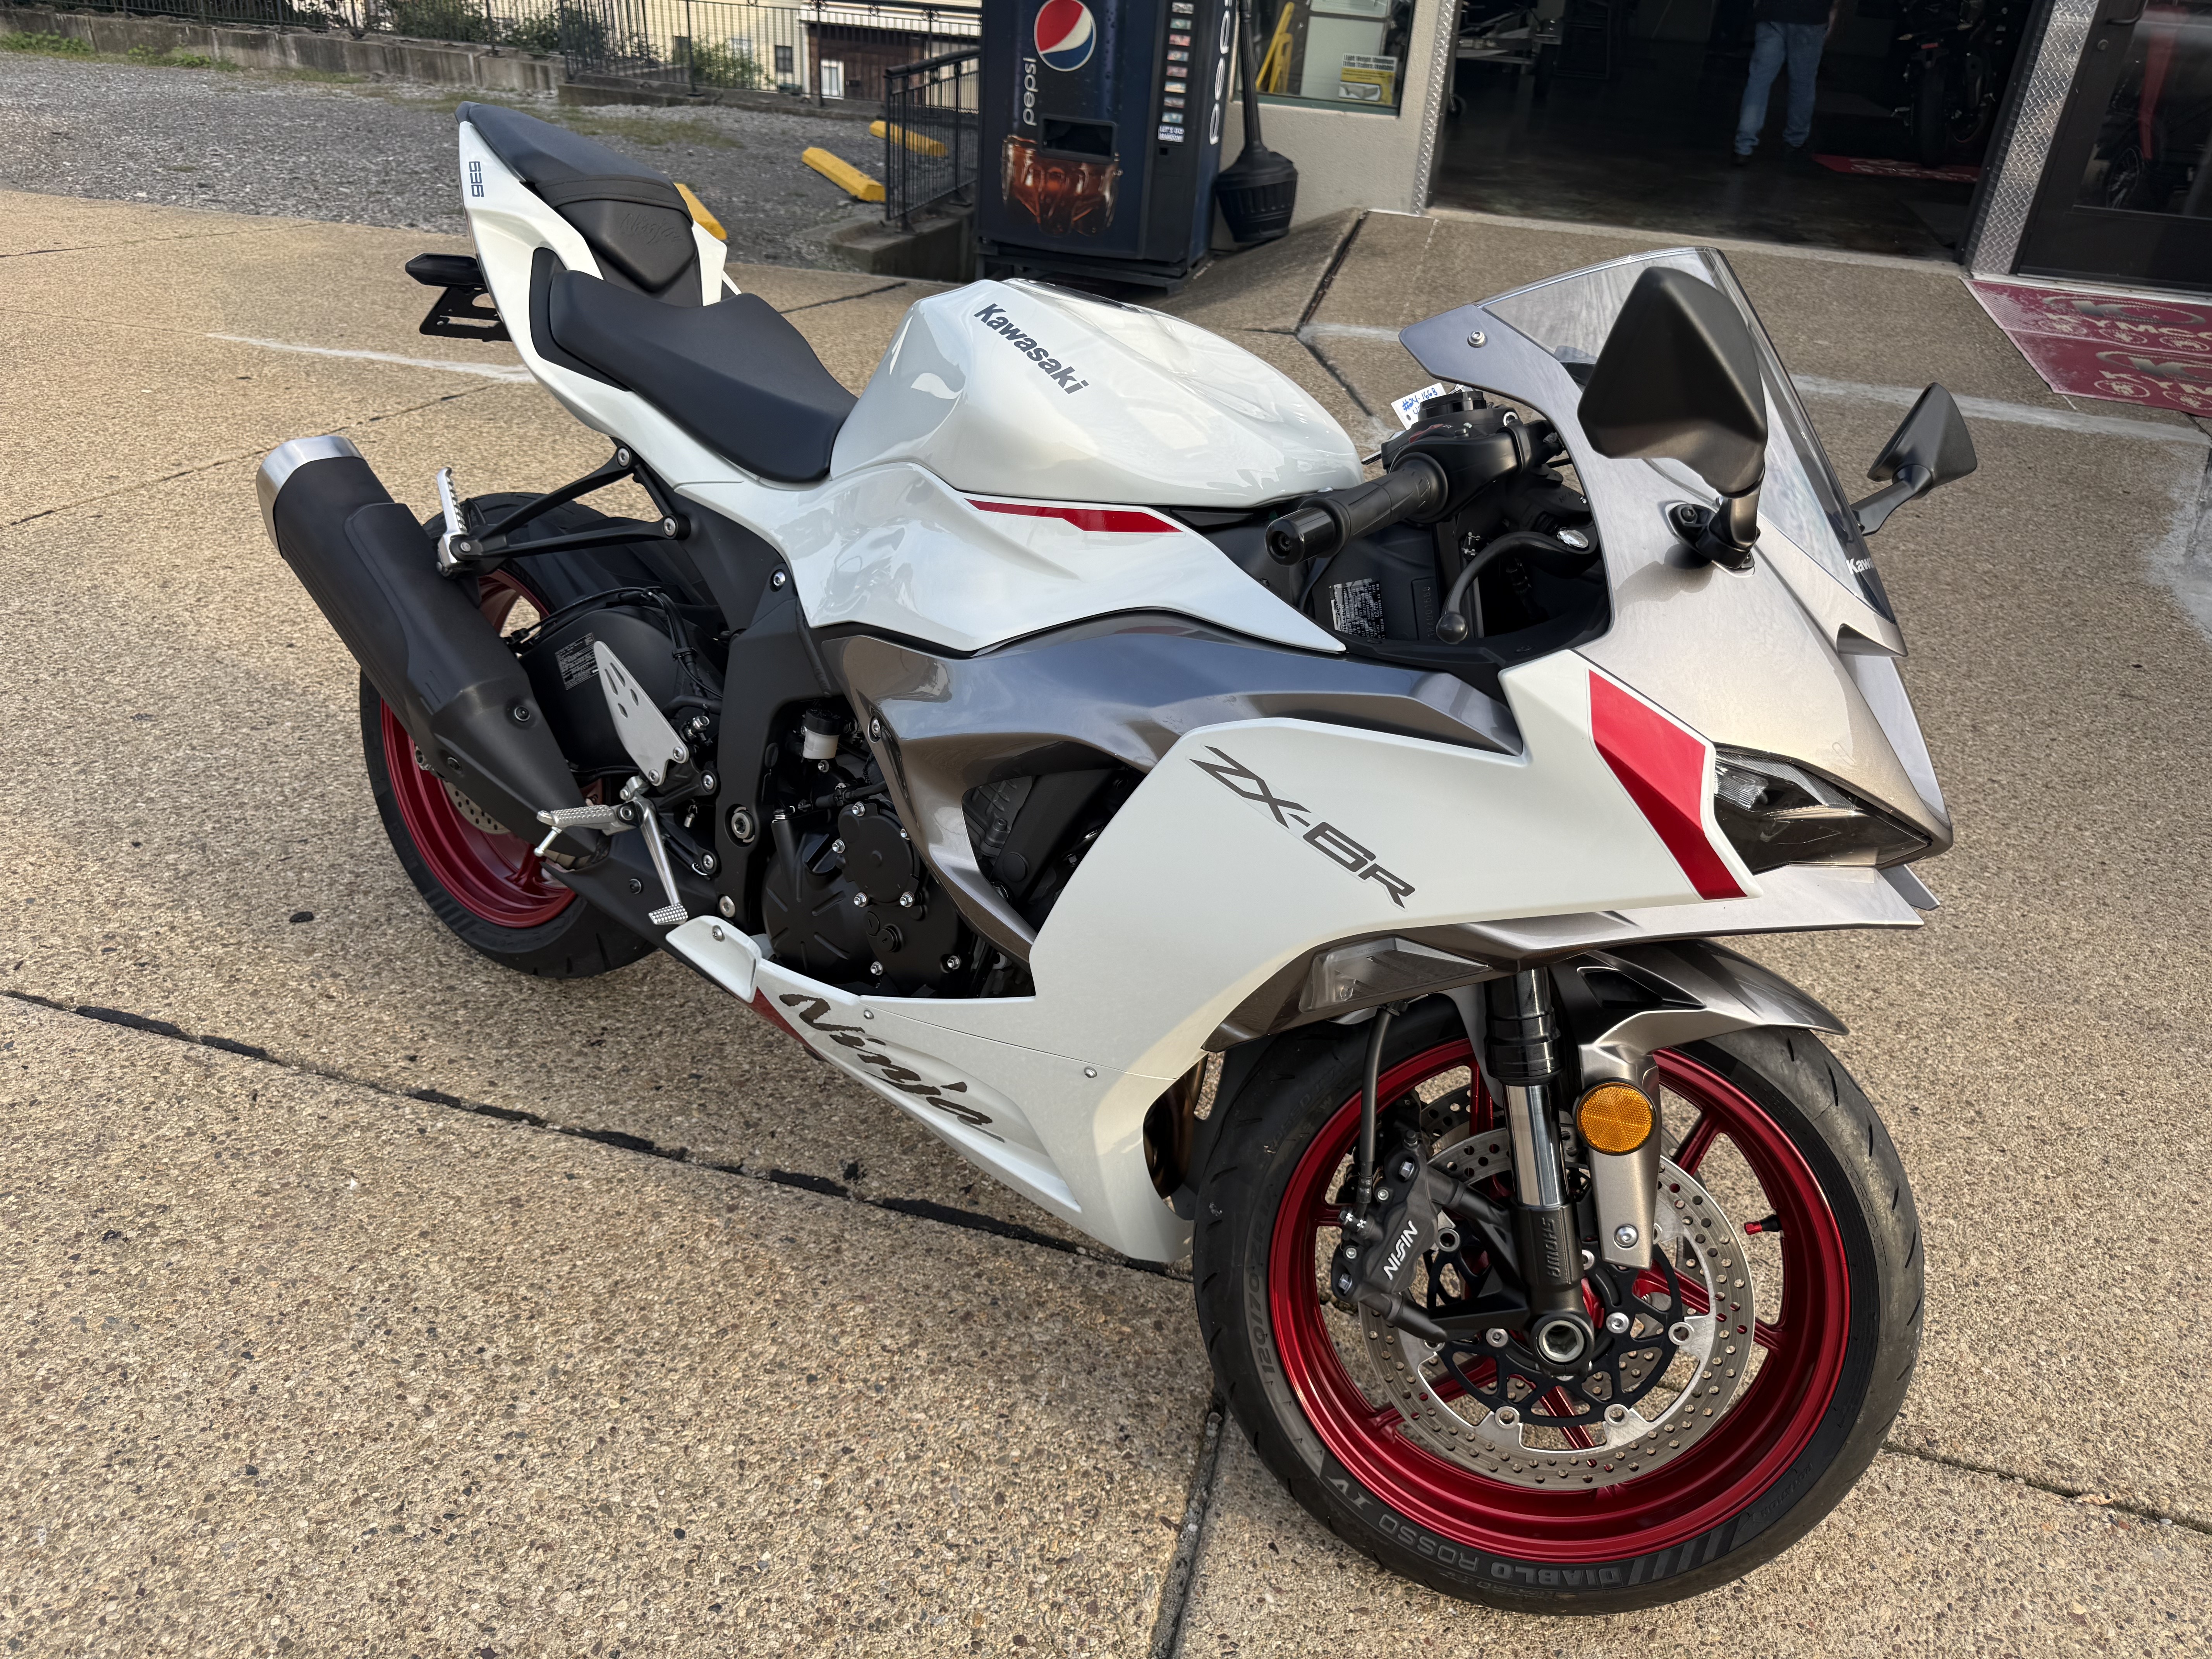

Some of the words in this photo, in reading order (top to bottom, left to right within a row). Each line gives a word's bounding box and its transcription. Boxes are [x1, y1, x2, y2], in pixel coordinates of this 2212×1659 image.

[1022, 57, 1038, 126] pepsi
[469, 161, 484, 198] 636
[974, 303, 1089, 395] Kawasaki
[2099, 369, 2212, 397] KYM
[1188, 745, 1415, 909] ZX-6R
[779, 993, 1005, 1143] Ninja
[1384, 1220, 1418, 1280] NISSIN
[1248, 1273, 1276, 1374] 120/70
[1326, 1476, 1373, 1510] IV
[1378, 1513, 1480, 1572] ROSSO
[1491, 1562, 1623, 1588] DIABLO
